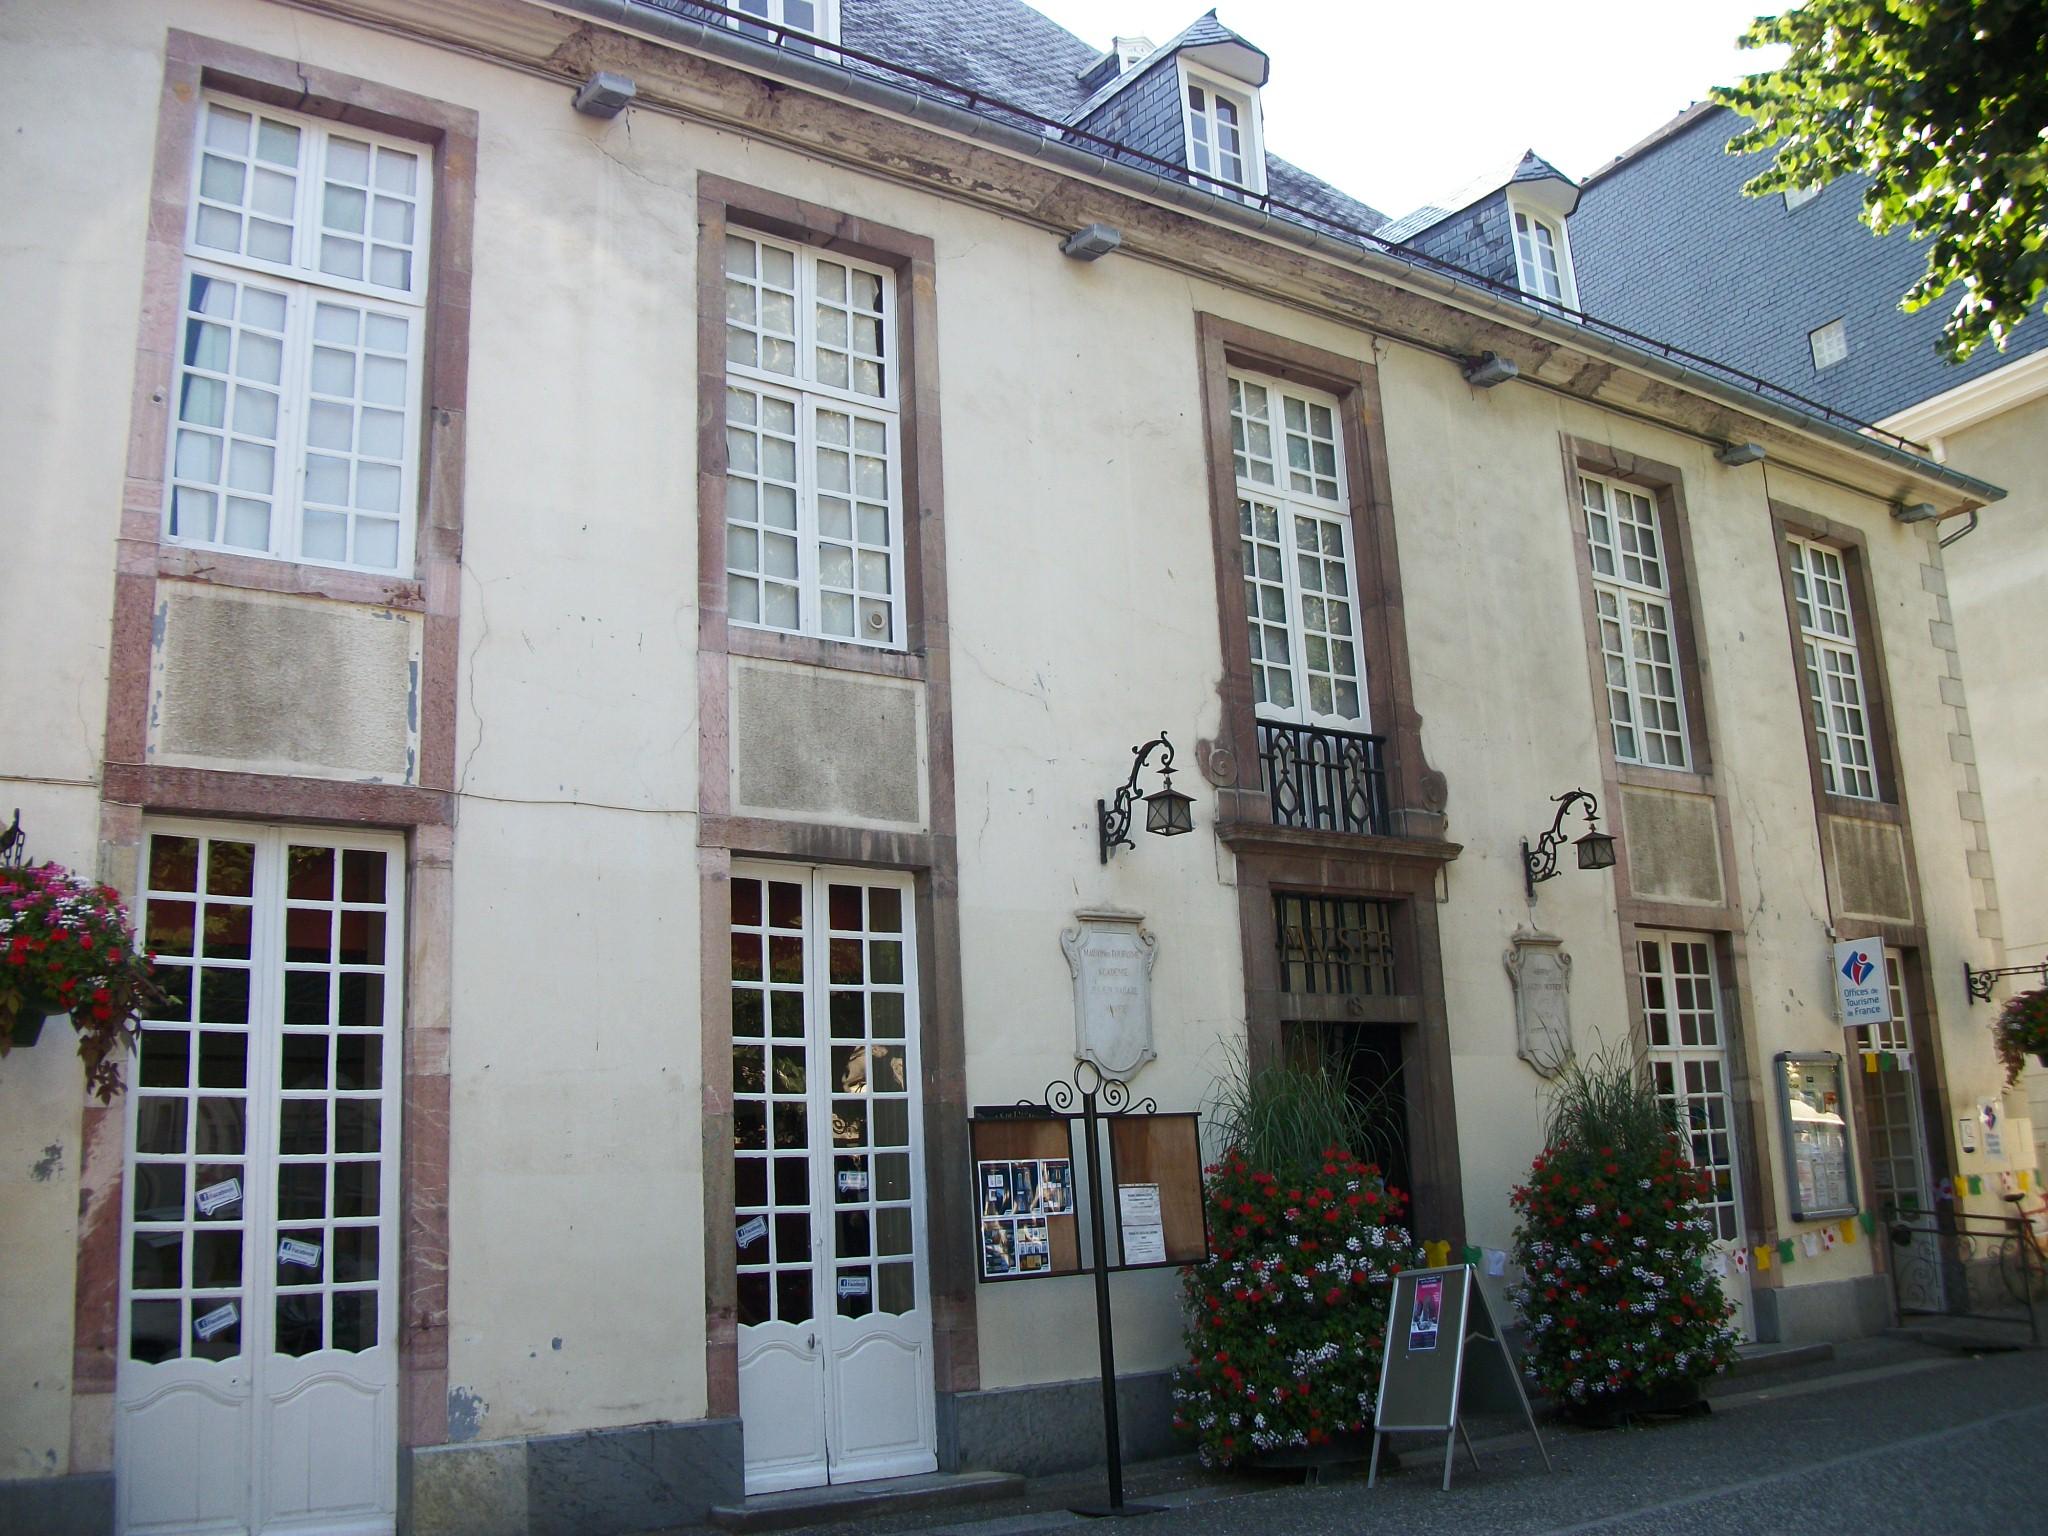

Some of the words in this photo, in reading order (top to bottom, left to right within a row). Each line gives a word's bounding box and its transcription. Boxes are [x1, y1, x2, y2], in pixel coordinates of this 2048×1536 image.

[1844, 988, 1869, 998] Offices
[1846, 997, 1880, 1006] Tourisme
[1855, 1006, 1881, 1016] France
